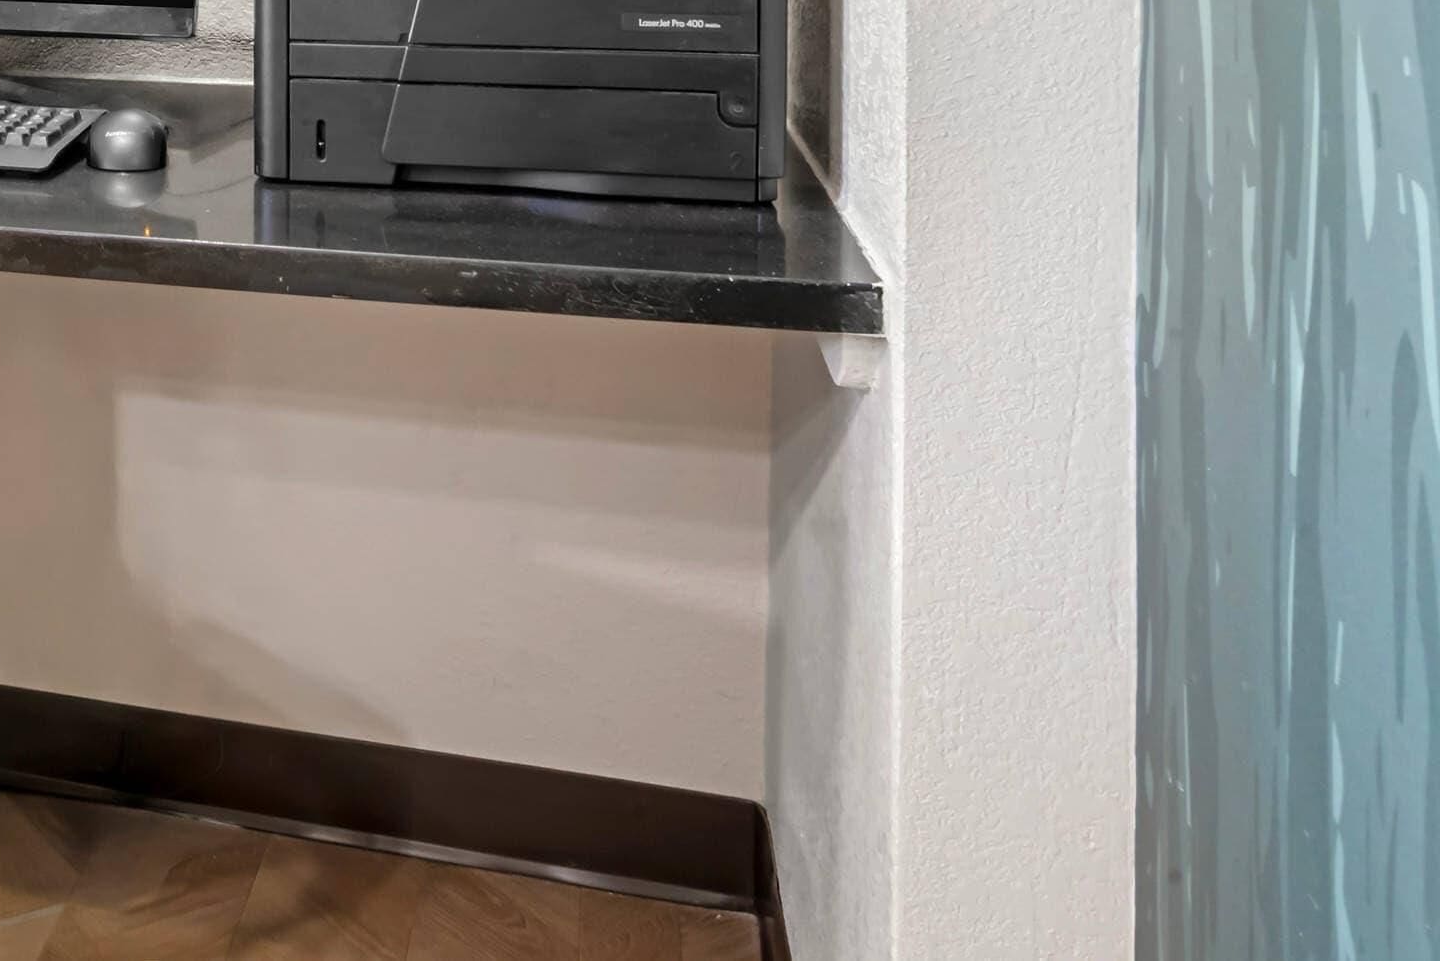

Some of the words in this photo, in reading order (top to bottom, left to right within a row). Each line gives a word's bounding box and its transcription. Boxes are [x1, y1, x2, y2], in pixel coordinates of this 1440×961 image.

[638, 18, 670, 27] LaserJet
[671, 19, 685, 28] Pro
[686, 19, 704, 28] 400
